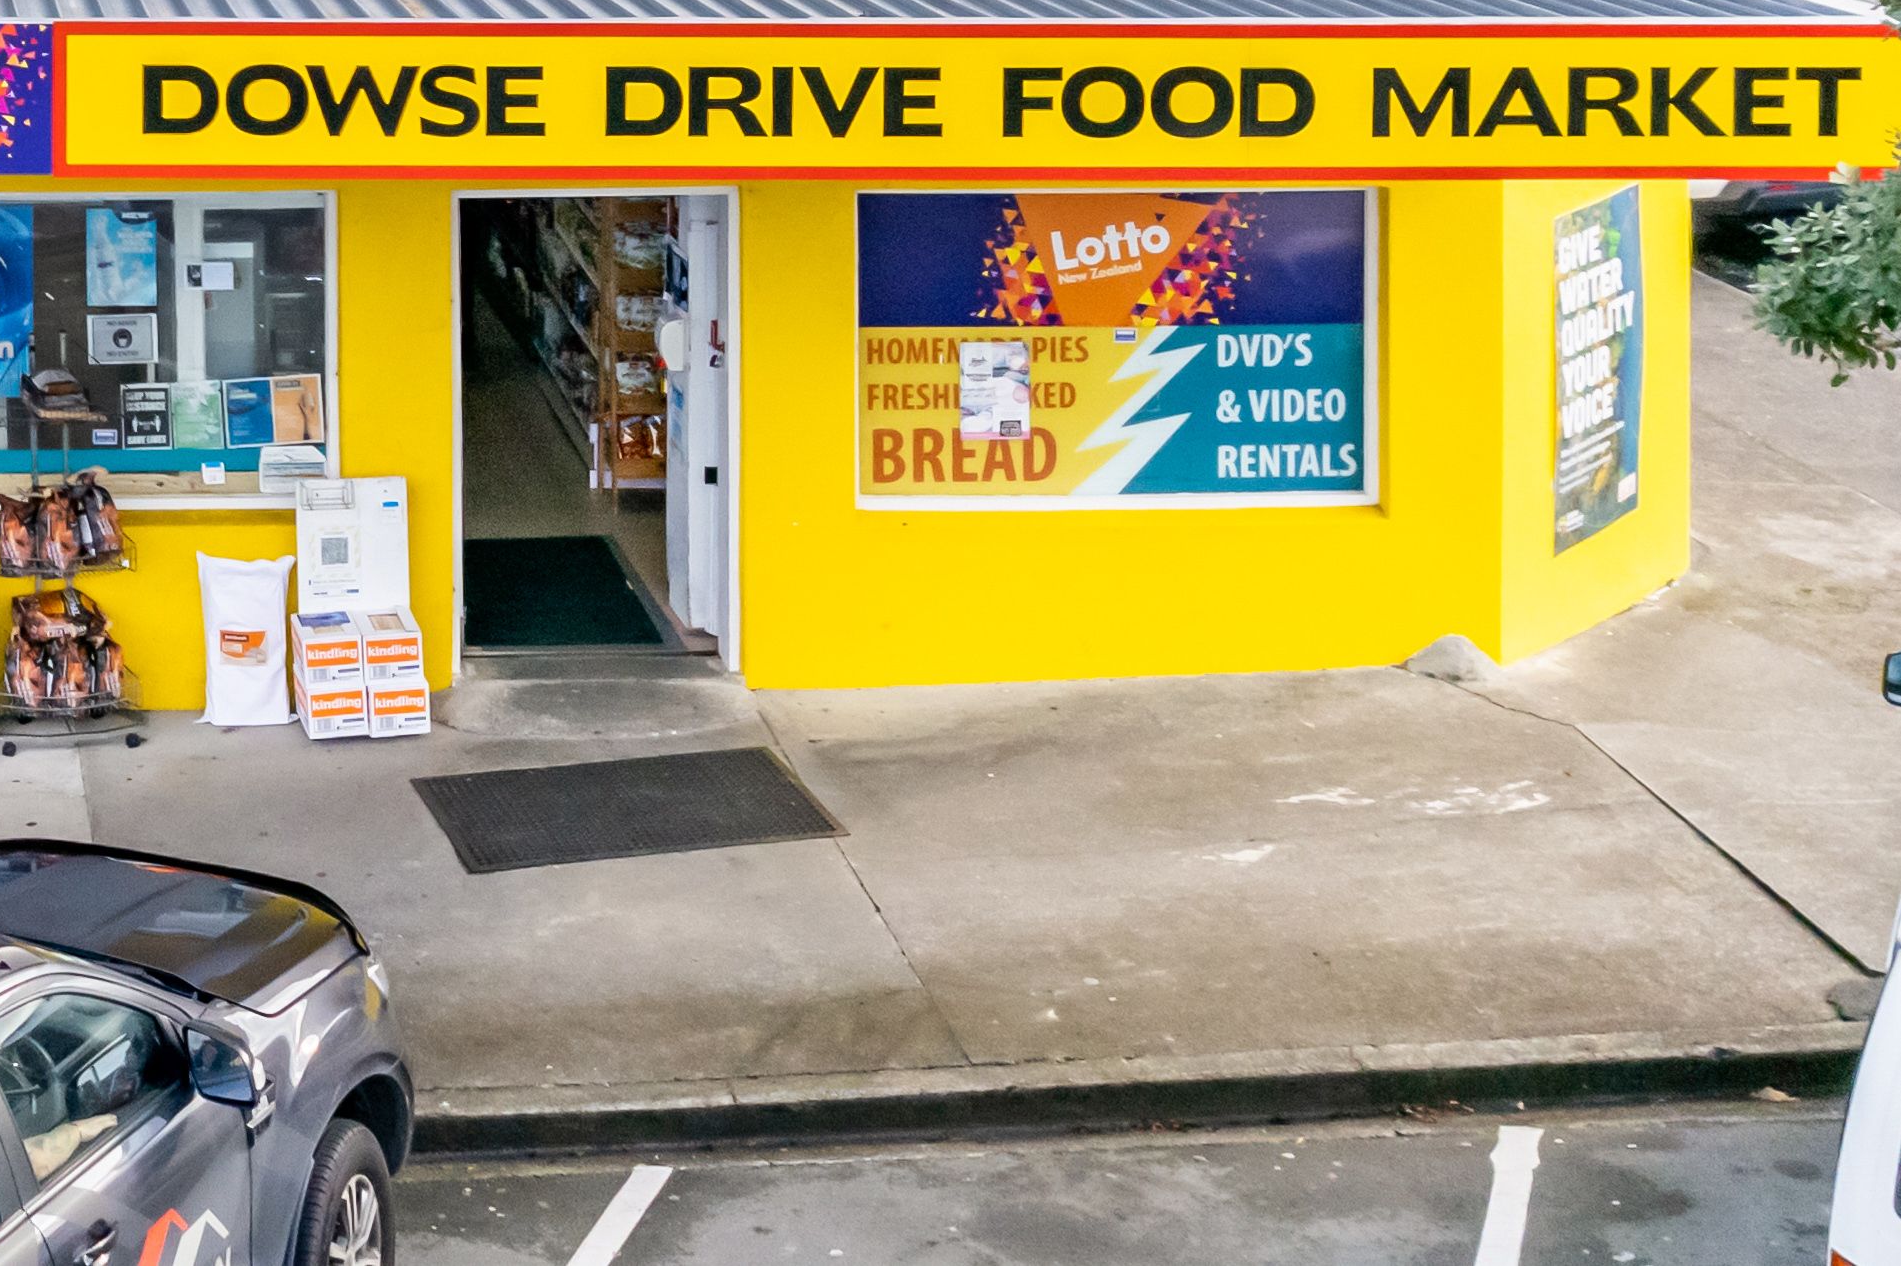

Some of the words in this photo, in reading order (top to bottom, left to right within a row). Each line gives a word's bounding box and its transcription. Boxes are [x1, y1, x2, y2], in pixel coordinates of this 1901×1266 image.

[141, 64, 546, 137] DOWSE
[605, 66, 943, 138] DRIVE
[1002, 65, 1315, 139] FOOD
[1371, 65, 1863, 139] MARKET
[1051, 220, 1171, 272] Lotto
[1557, 224, 1603, 275] GIVE
[1057, 271, 1088, 286] New
[1090, 259, 1143, 281] Zealand
[1559, 257, 1625, 316] WATER
[1561, 290, 1635, 357] QUALITY
[1031, 335, 1089, 363] PIES
[1216, 333, 1314, 369] DVD'S
[1561, 344, 1613, 399] YOUR
[1216, 390, 1242, 423] &
[1248, 388, 1347, 423] VIDEO
[1561, 382, 1615, 440] VOICE
[872, 426, 1057, 483] BREAD
[1217, 442, 1359, 479] RENTALS
[307, 645, 359, 662] kindling
[367, 643, 418, 658] kindling
[312, 695, 363, 712] kindling
[374, 694, 425, 709] kindling
